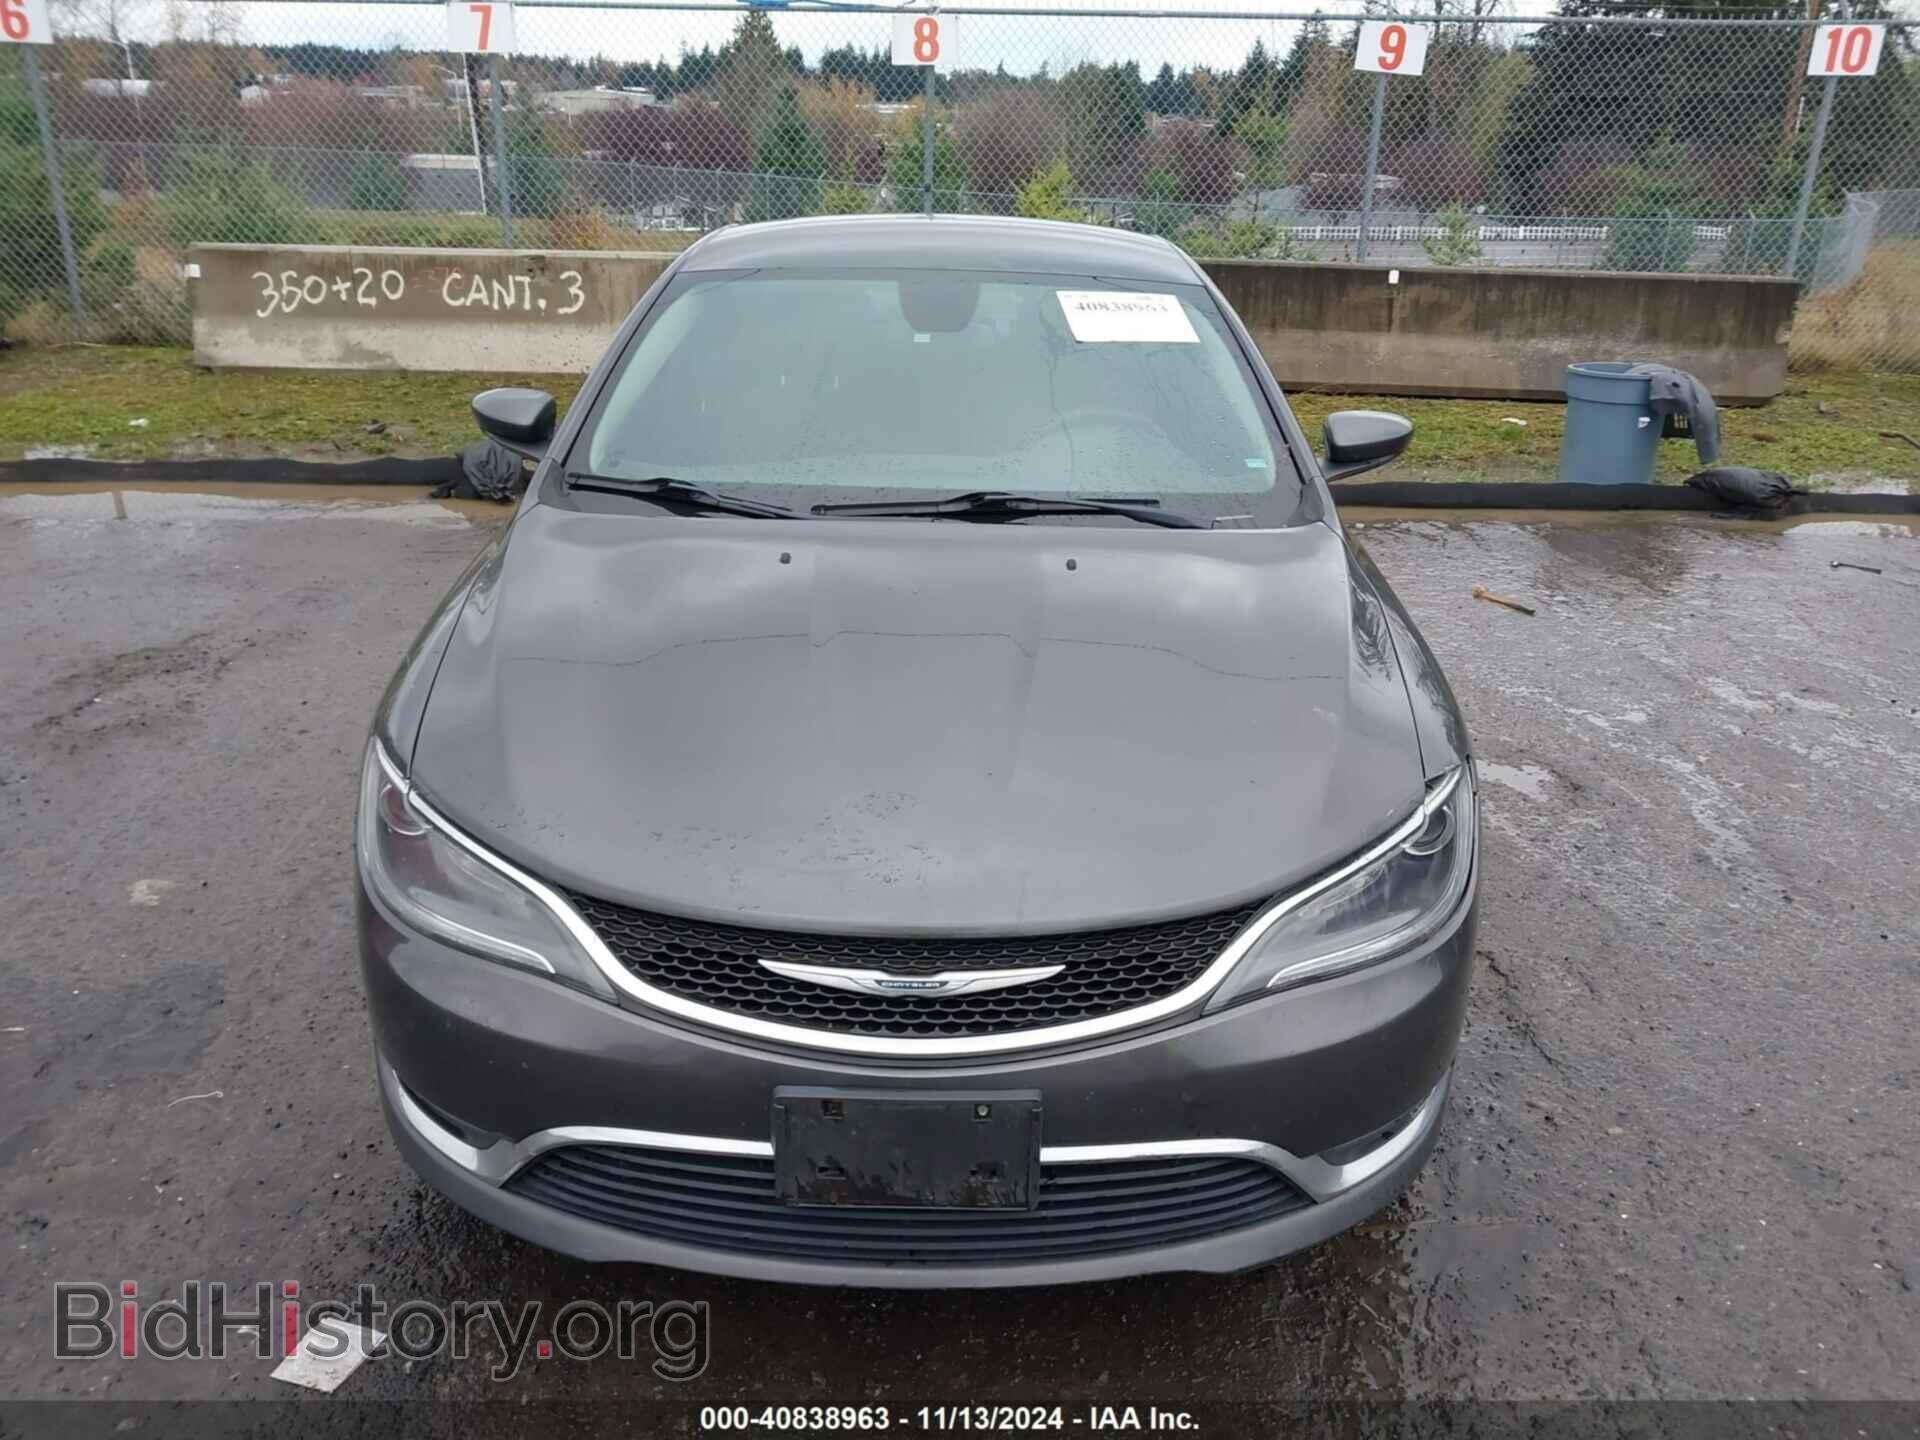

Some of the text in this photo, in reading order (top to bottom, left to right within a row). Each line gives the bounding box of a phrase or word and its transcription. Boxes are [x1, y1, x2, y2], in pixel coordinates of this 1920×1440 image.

[470, 4, 493, 50] 7
[913, 17, 940, 62] 8
[1376, 24, 1407, 71] 9
[1824, 26, 1873, 74] 10
[442, 273, 547, 313] CANT.
[556, 270, 586, 315] 3
